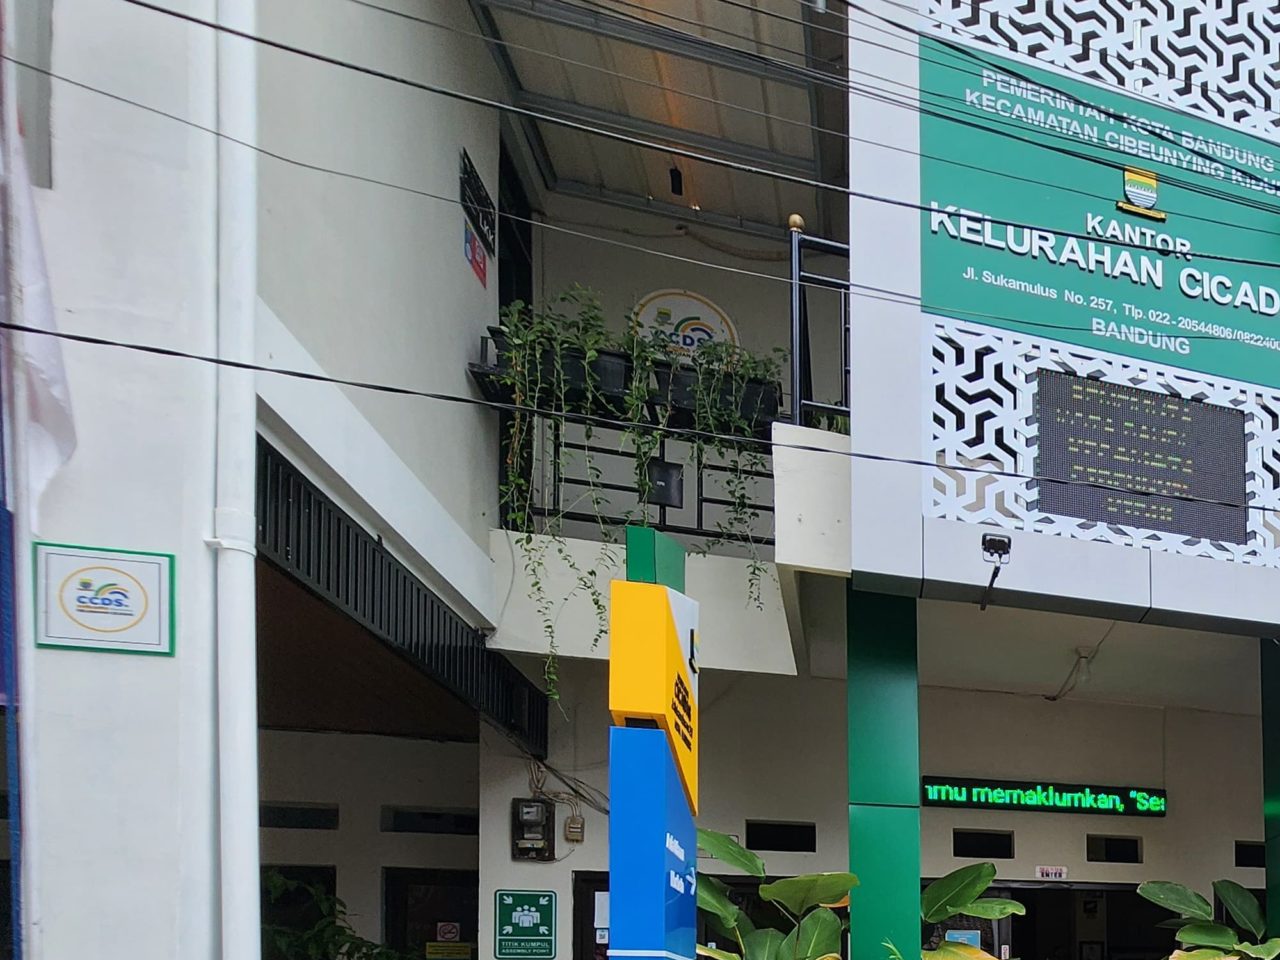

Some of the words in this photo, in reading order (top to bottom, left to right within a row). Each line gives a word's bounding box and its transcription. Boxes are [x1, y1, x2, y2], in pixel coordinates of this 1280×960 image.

[965, 88, 1098, 142] KECAMATAN
[1104, 131, 1225, 180] CIBEUNYING
[982, 69, 1114, 126] PEMERINTAH
[1123, 112, 1176, 142] KOTA
[1181, 130, 1274, 173] BANDUNG
[930, 201, 1163, 289] KELURAHAN
[1086, 212, 1193, 260] KANTOR
[962, 266, 978, 280] Jl.
[982, 271, 1057, 299] Sukamulus
[1064, 289, 1087, 306] No.
[1090, 295, 1117, 315] 257,
[1092, 317, 1190, 354] BANDUNG
[972, 785, 1124, 812] memaklumkan,
